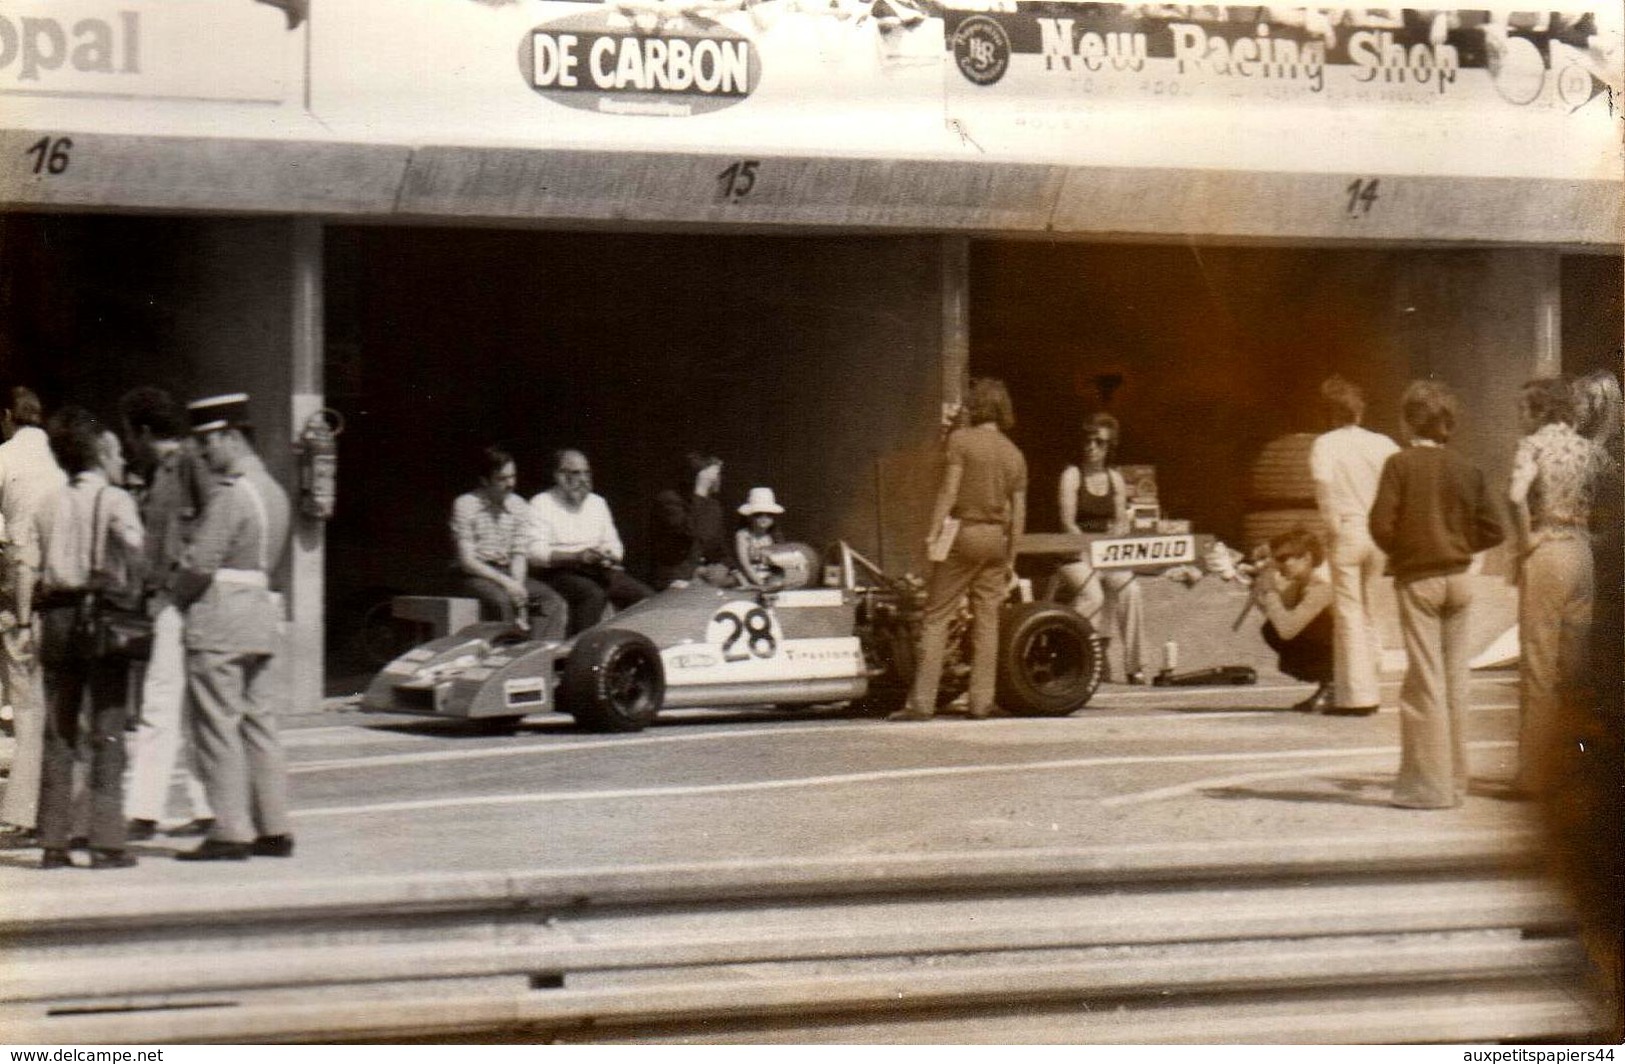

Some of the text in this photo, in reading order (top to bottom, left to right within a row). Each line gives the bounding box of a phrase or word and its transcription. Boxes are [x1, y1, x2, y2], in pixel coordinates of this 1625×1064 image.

[533, 33, 749, 93] DE CARBON
[1036, 18, 1459, 94] New Racing Shop
[25, 136, 73, 175] 16
[717, 160, 761, 198] 15
[1346, 177, 1380, 215] 14
[1102, 539, 1189, 563] ARNOLD
[713, 607, 777, 662] 28
